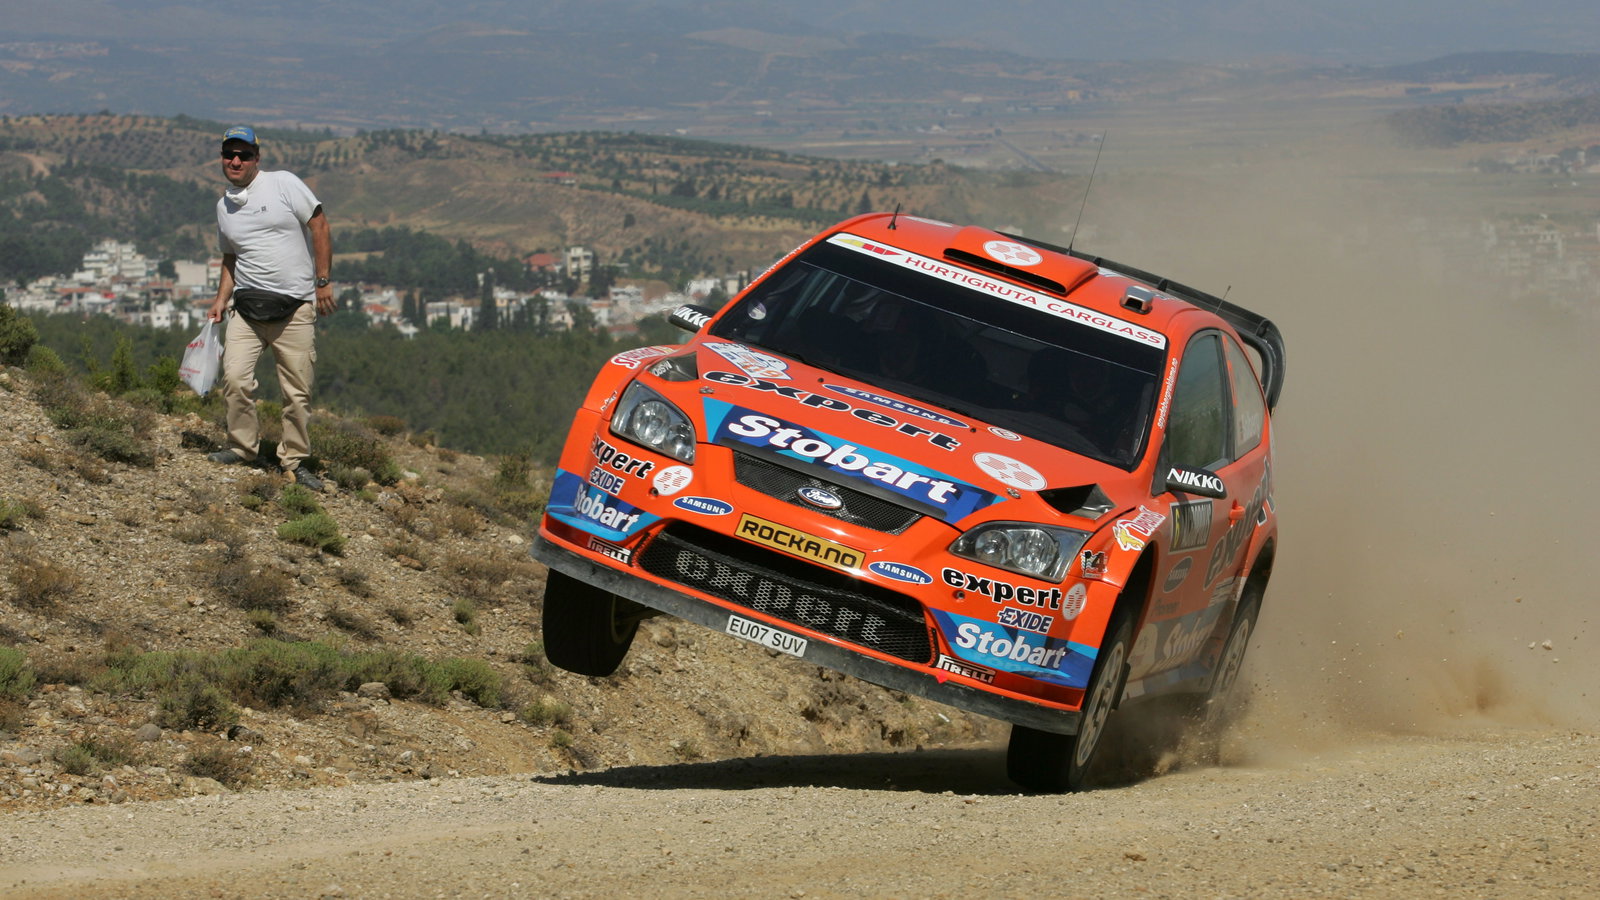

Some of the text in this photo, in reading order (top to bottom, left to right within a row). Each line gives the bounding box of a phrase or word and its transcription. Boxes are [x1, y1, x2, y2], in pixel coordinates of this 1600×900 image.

[905, 256, 1162, 345] HURTIGRUTA CARGLASS
[703, 370, 962, 452] expert
[845, 388, 952, 425] SAMSUNG
[728, 414, 957, 504] Stobart
[589, 466, 625, 496] EXIDE
[805, 489, 841, 505] Ford
[1167, 467, 1224, 493] NIKKO
[574, 483, 640, 533] Stobart
[682, 496, 726, 515] SAMSUNG
[587, 535, 632, 565] PIRELLI
[742, 520, 858, 569] ROCKA.NO
[878, 561, 926, 584] SAMSUNG
[941, 567, 1062, 610] expert
[675, 549, 886, 645] expert
[730, 618, 804, 654] EU07 SUV
[998, 606, 1053, 634] EXIDE
[955, 622, 1067, 669] Stobart
[936, 653, 996, 684] PIRELLI
